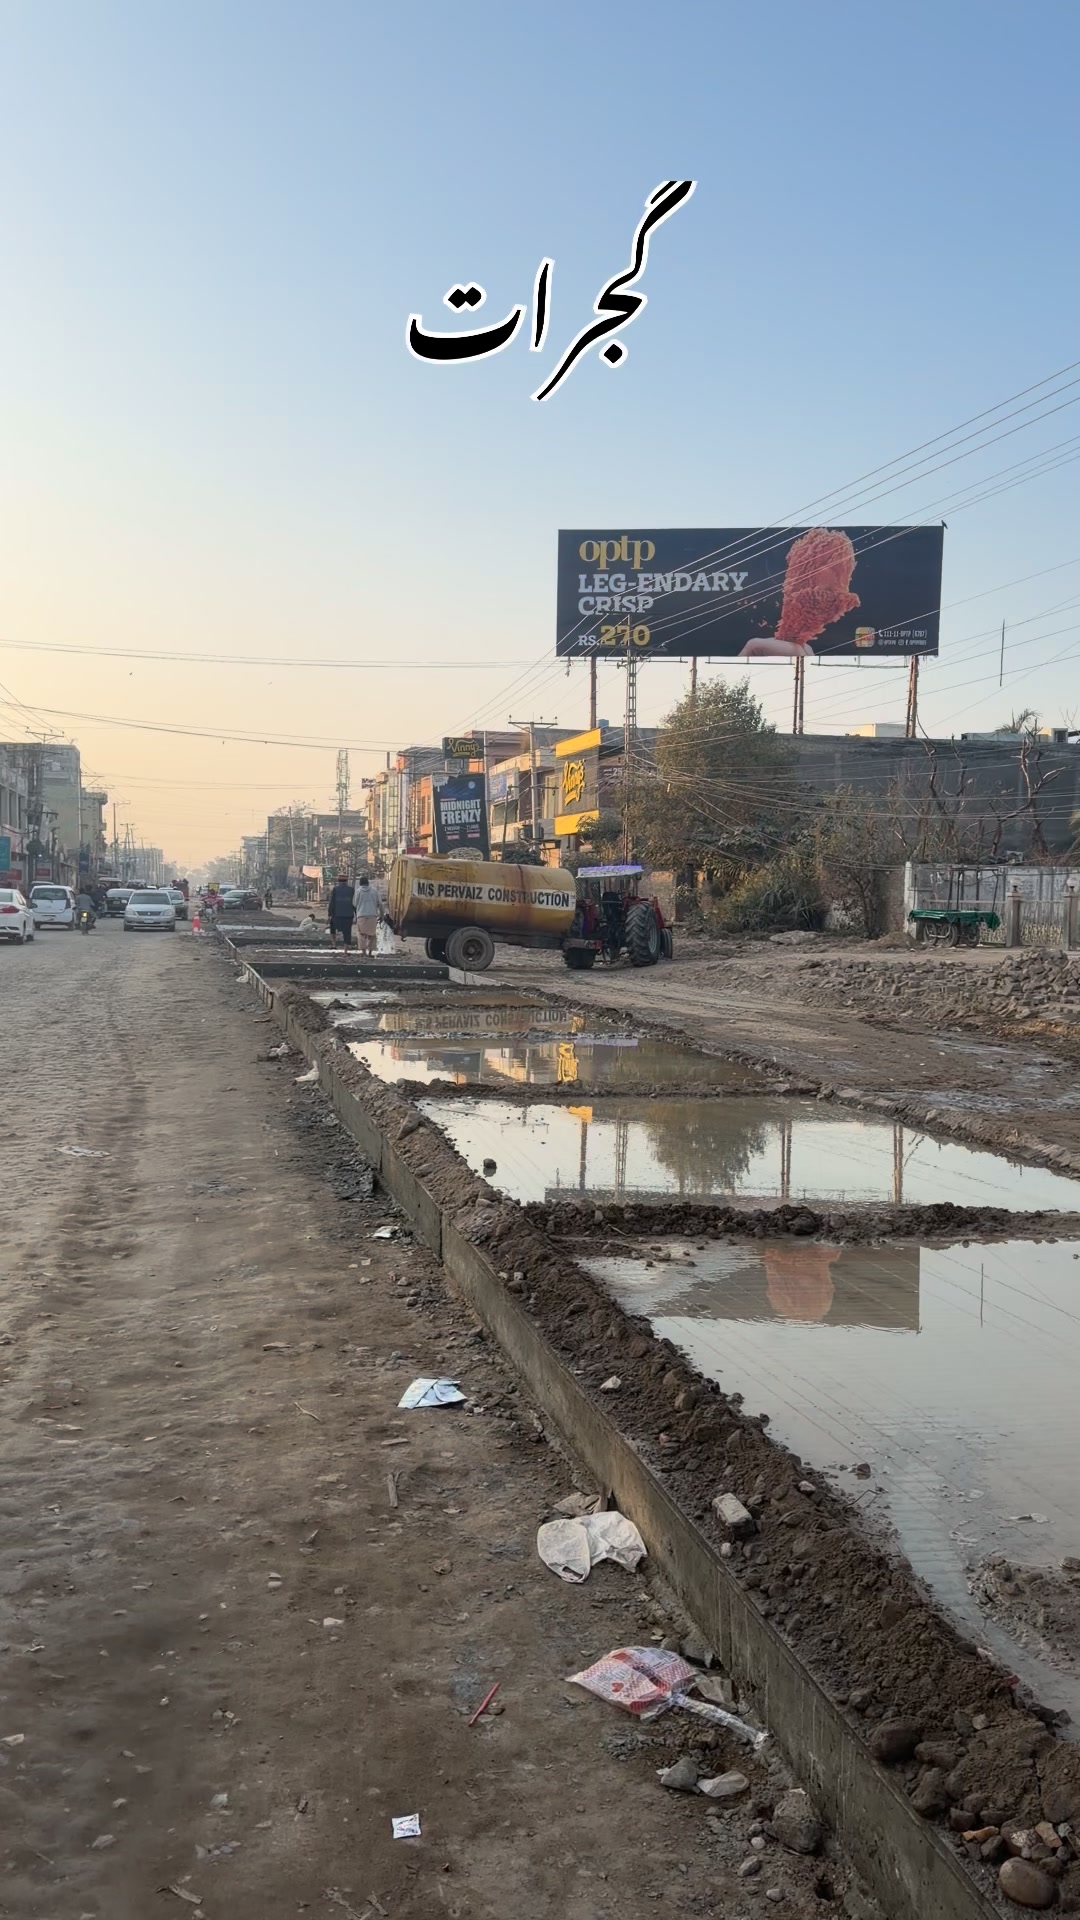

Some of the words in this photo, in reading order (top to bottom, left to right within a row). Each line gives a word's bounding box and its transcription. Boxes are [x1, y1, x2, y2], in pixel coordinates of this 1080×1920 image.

[578, 535, 656, 570] optp
[577, 571, 749, 593] LEG-ENDARY
[577, 595, 654, 616] CRISP
[440, 799, 481, 812] MIDNIGHT
[440, 809, 482, 825] FRENZY
[437, 884, 483, 900] PERVAIZ
[487, 887, 570, 907] CONSTRUCTION
